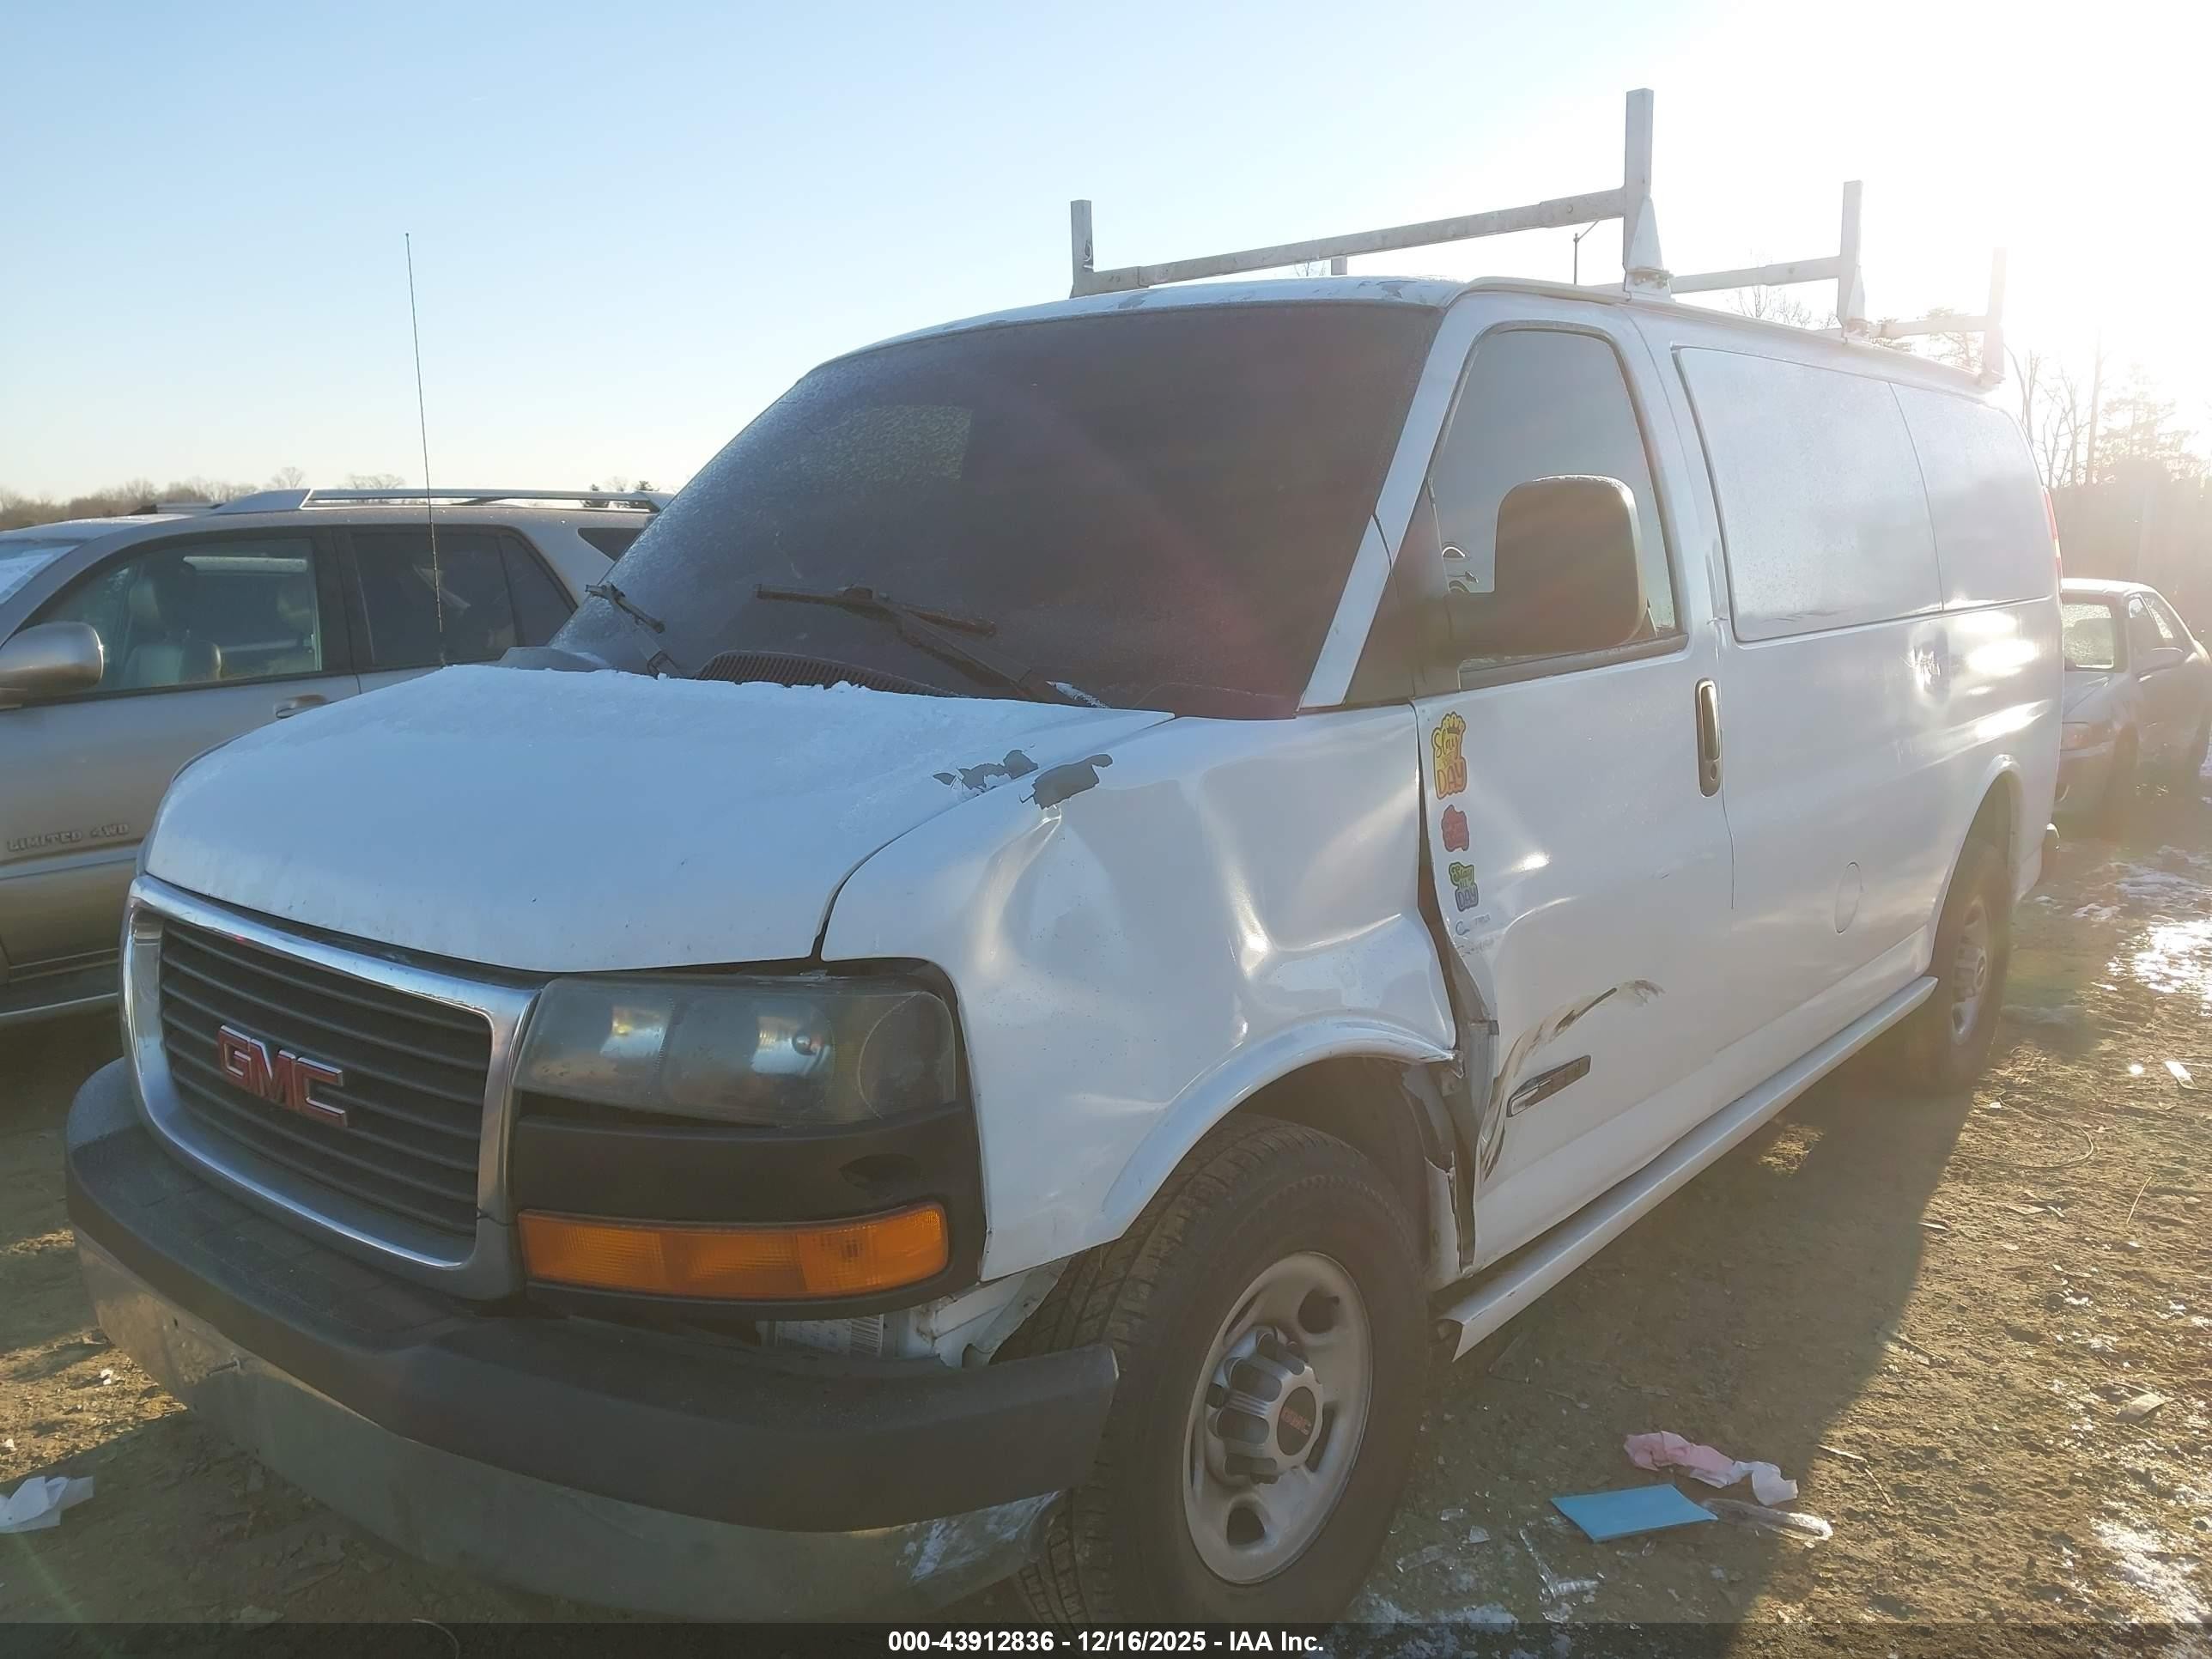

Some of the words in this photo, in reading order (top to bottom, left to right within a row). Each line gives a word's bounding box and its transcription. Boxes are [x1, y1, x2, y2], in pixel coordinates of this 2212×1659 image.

[1437, 761, 1464, 794] DAY
[7, 830, 82, 852] LIMITED
[90, 823, 130, 839] 4WD
[1457, 886, 1477, 908] DAY
[218, 1024, 348, 1127] GMC
[1280, 1407, 1312, 1436] GMC
